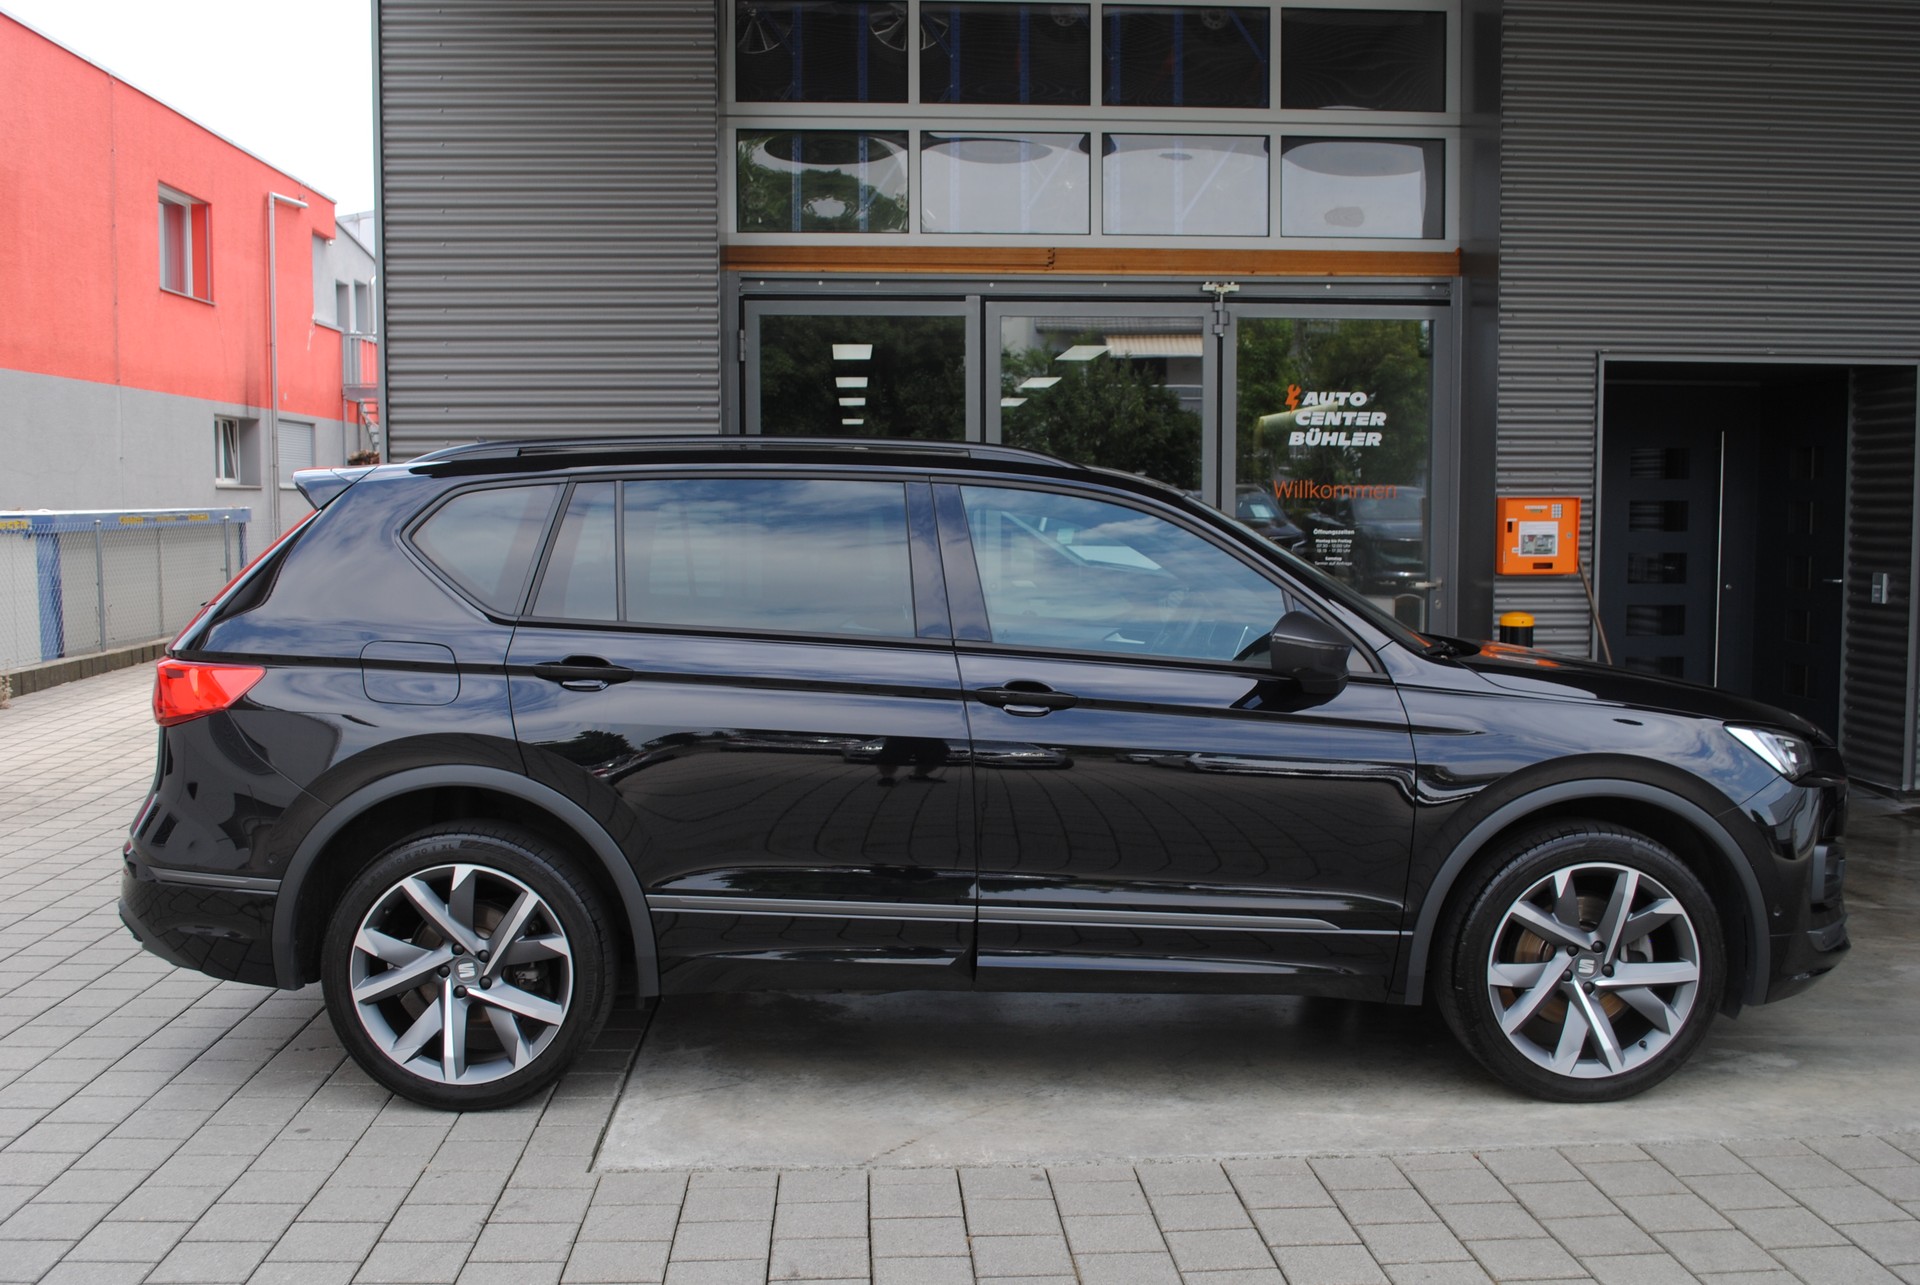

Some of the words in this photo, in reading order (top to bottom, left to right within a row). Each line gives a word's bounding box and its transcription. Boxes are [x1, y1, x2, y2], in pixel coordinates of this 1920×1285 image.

[1302, 391, 1368, 407] AUTO
[1295, 411, 1387, 426] CENTER
[1288, 427, 1382, 446] BÜHLER
[1273, 480, 1397, 499] Willkommen
